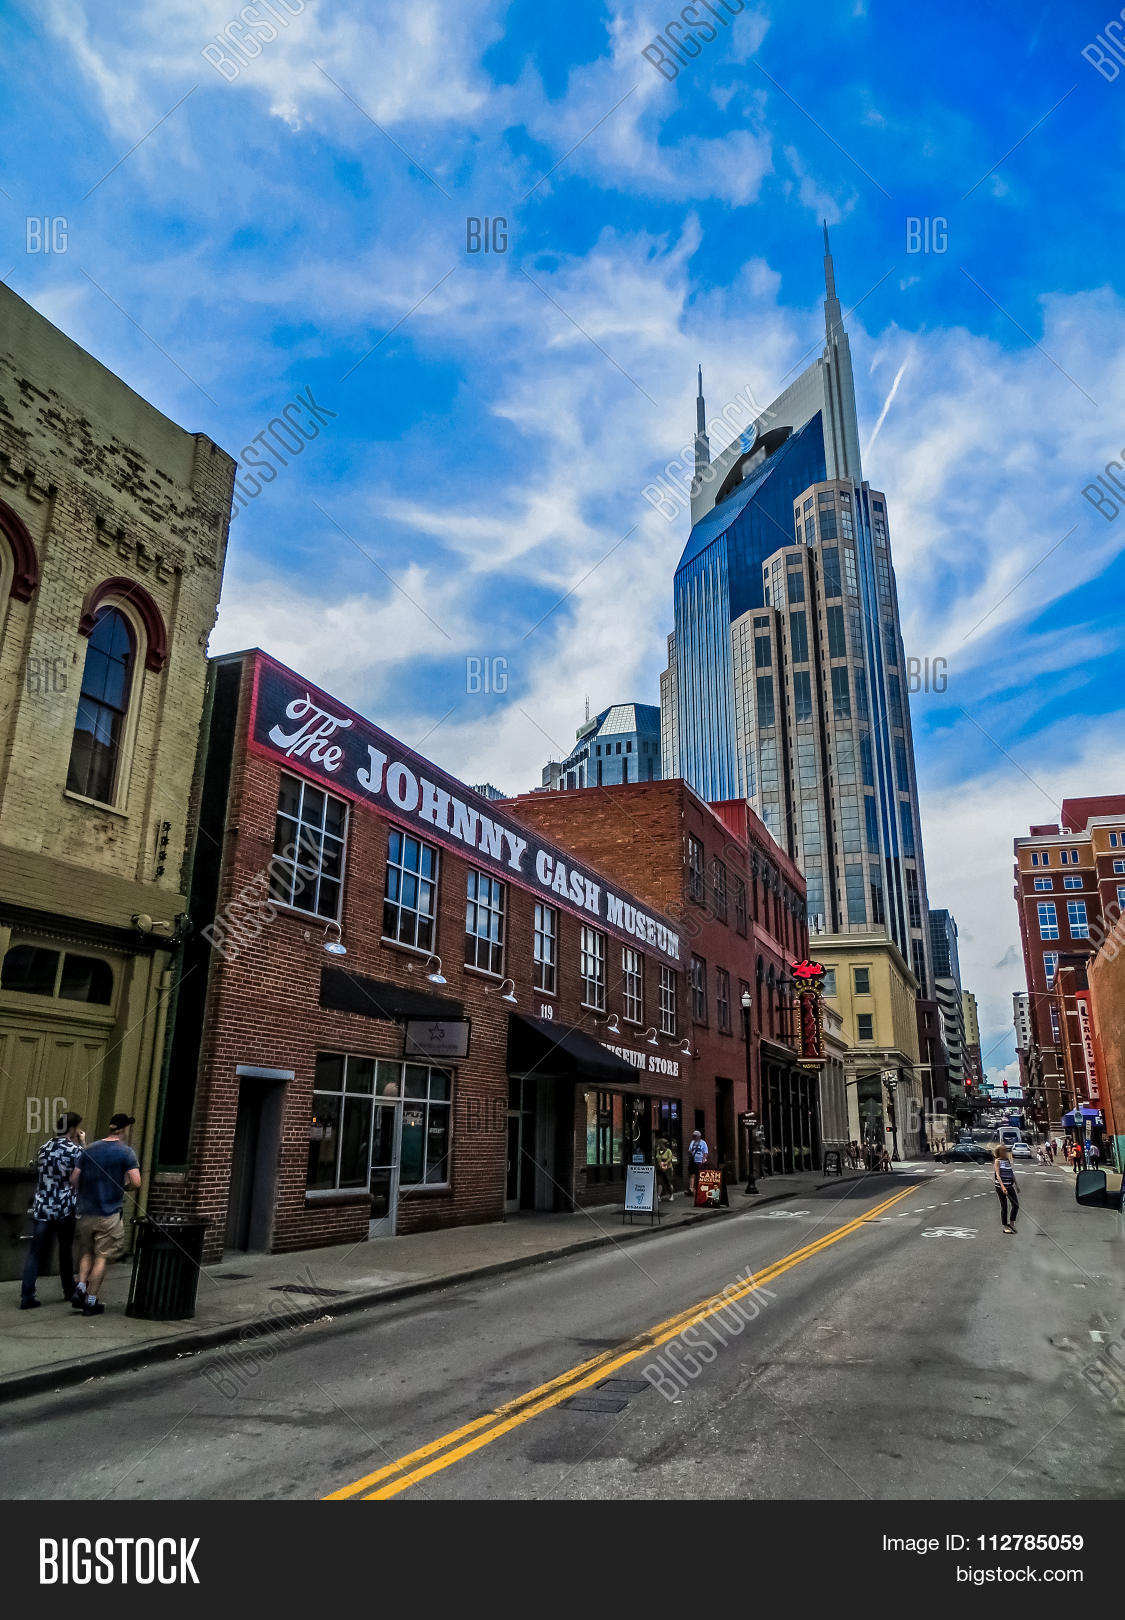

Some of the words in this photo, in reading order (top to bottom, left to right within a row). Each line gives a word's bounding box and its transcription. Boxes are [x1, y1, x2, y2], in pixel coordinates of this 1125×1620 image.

[268, 692, 353, 772] The
[356, 744, 528, 872] JOHNNY
[535, 849, 601, 916] CASH
[606, 891, 680, 961] MUSEUM
[540, 1003, 553, 1020] 119
[1082, 1018, 1094, 1057] TRAIL
[648, 1055, 679, 1077] STORE
[1087, 1061, 1100, 1094] WEST
[699, 1171, 721, 1179] CASH
